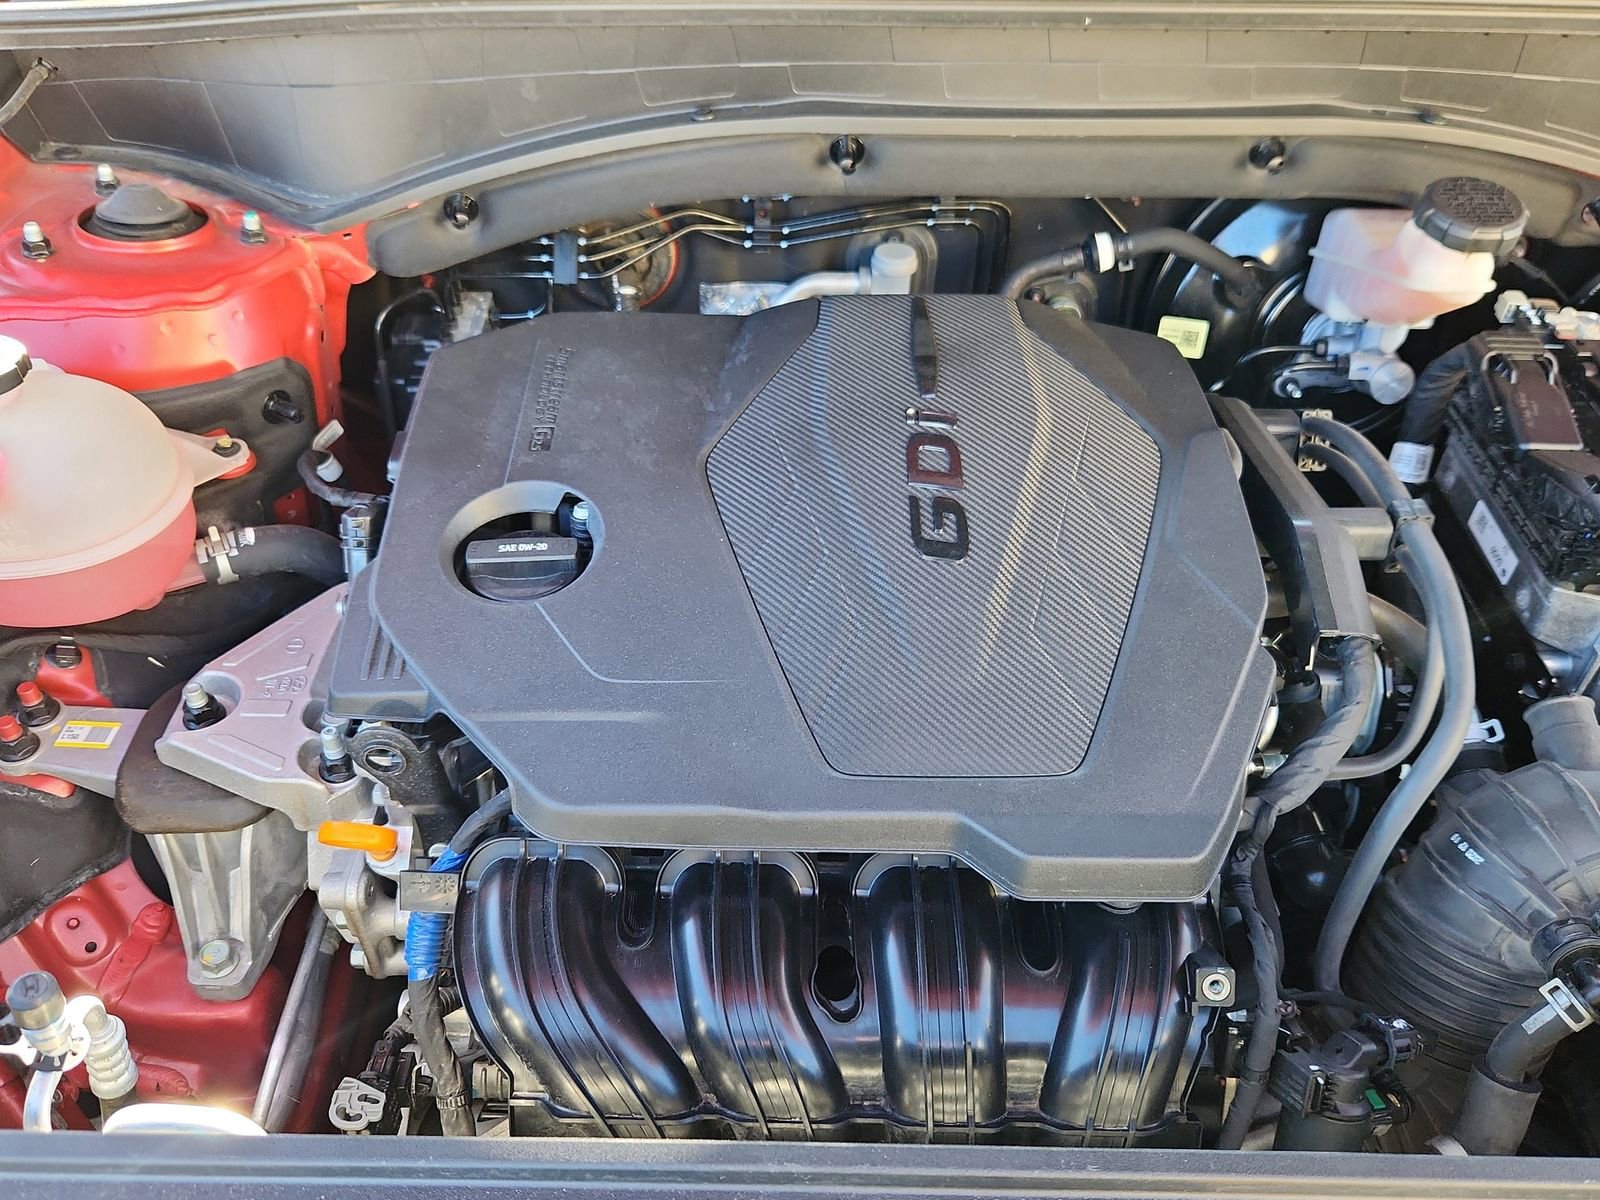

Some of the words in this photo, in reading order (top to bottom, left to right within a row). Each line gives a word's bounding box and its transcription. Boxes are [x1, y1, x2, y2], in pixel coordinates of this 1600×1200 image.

[535, 353, 557, 421] TECHNOLOGY
[545, 346, 576, 425] Smartstream
[497, 544, 518, 553] SAE
[517, 542, 549, 552] 0W-20
